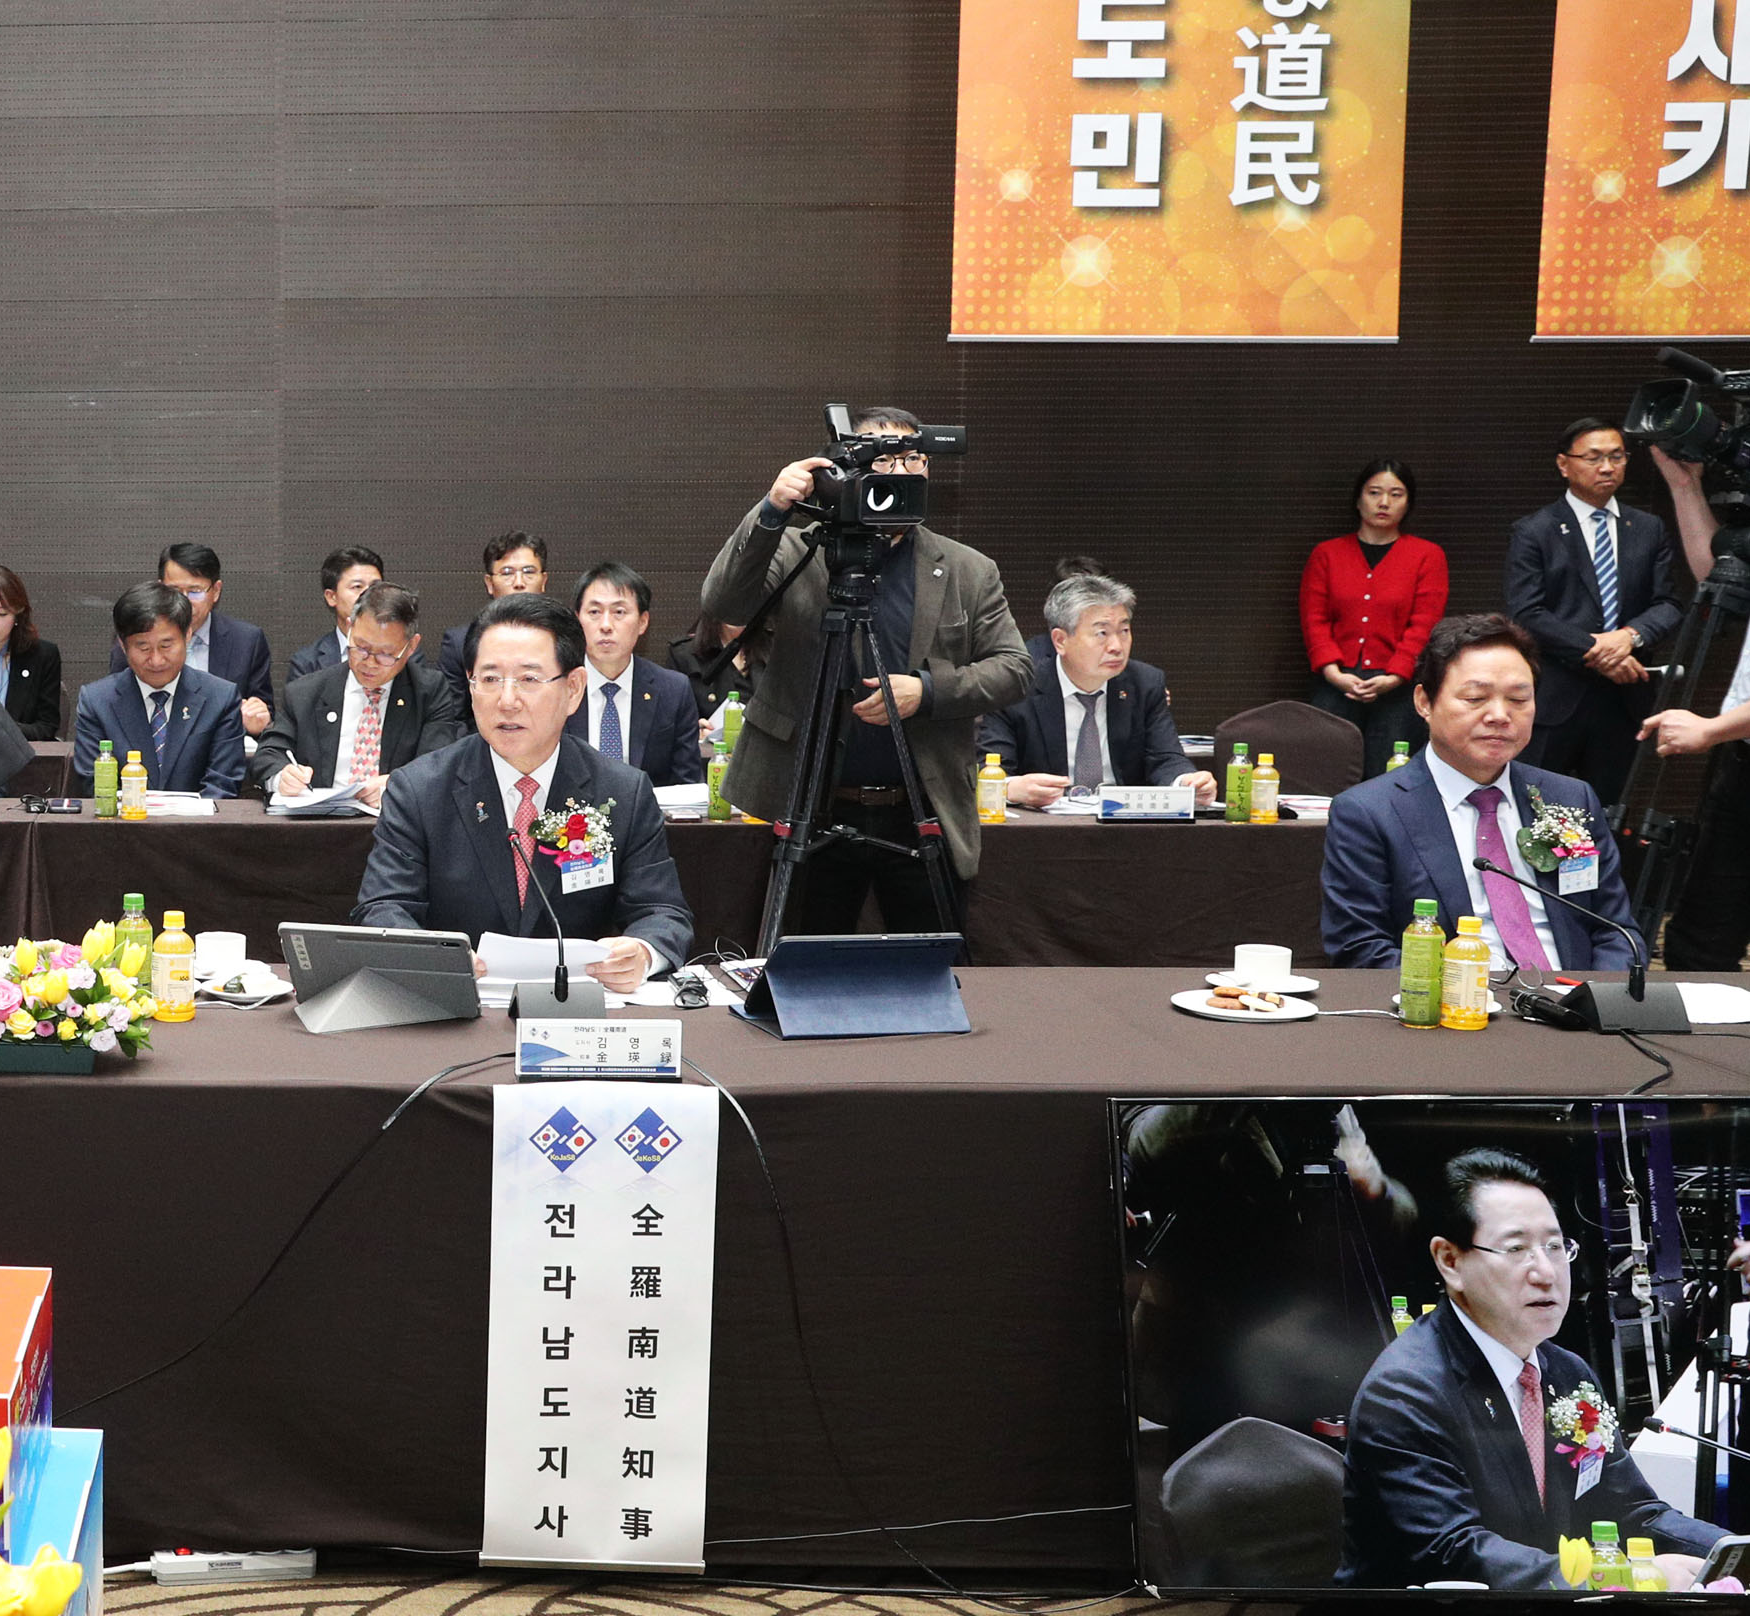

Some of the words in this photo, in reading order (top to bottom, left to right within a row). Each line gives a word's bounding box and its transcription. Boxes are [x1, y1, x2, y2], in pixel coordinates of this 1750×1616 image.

[1229, 0, 1331, 206] 道民
[534, 1203, 576, 1539] 전라남도지사
[619, 1203, 664, 1540] 全羅南道知事
